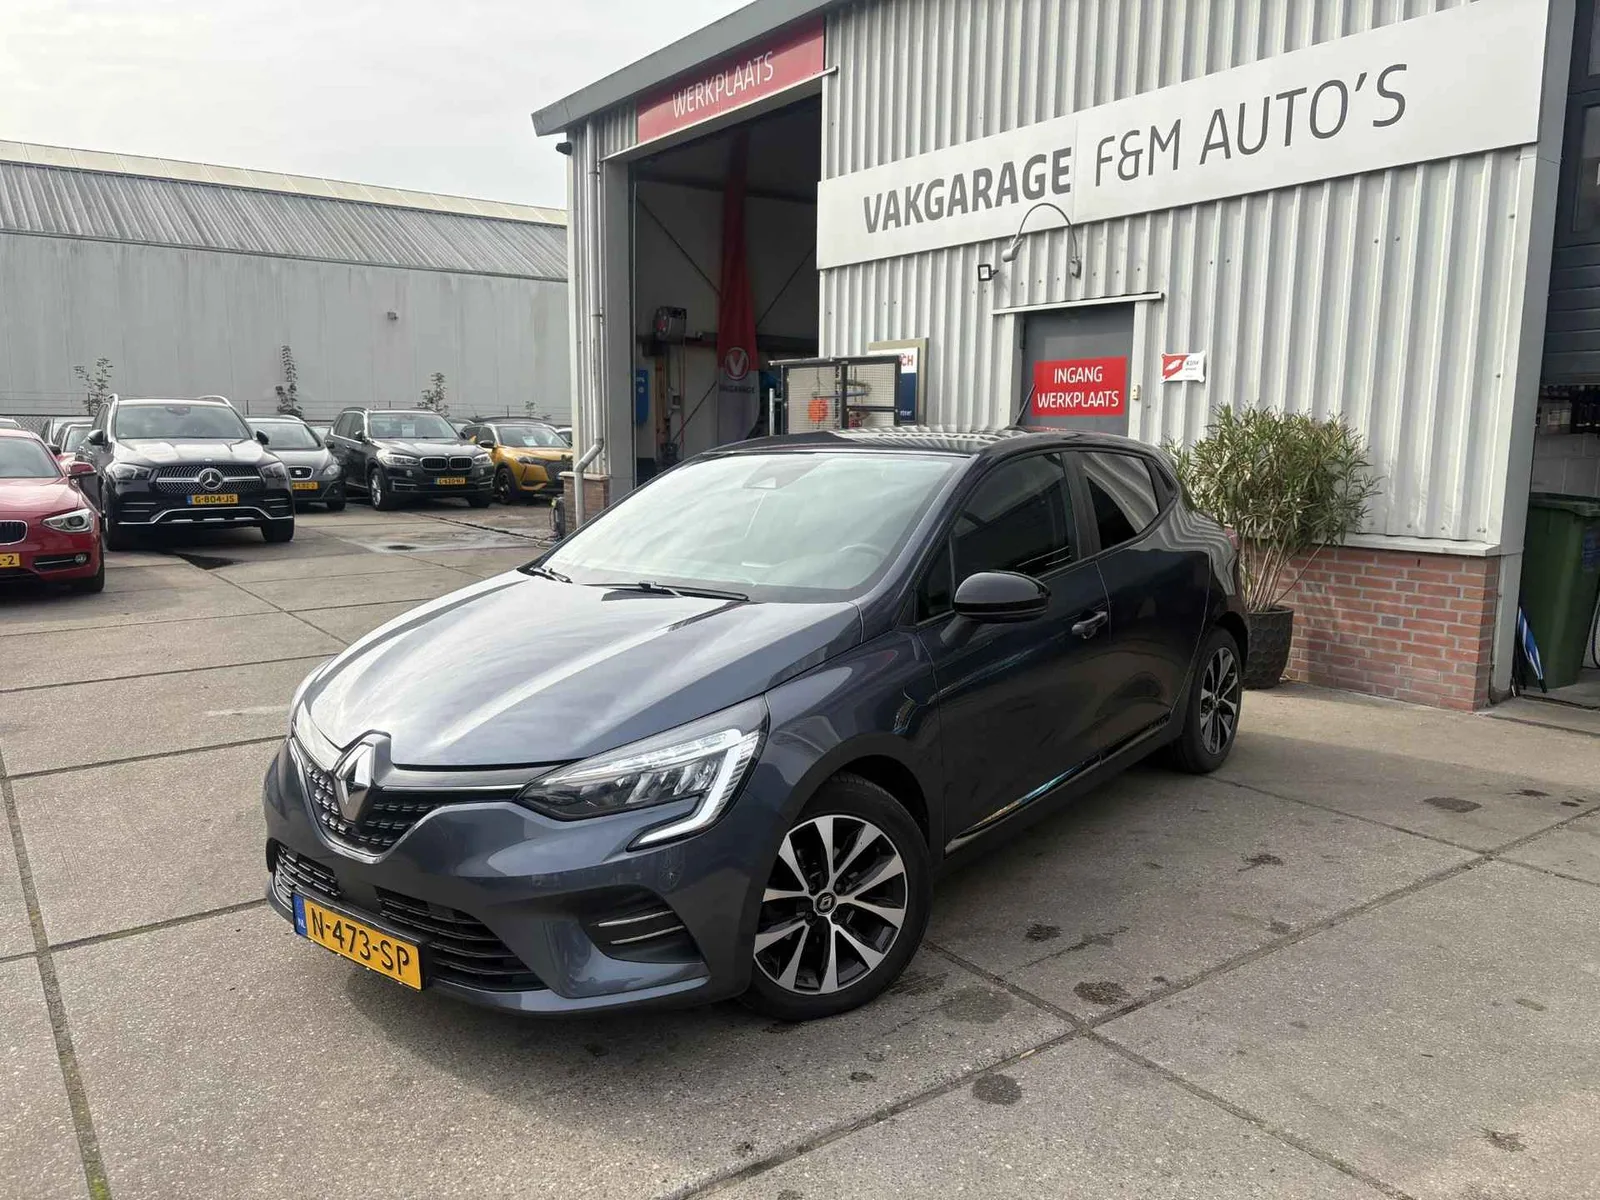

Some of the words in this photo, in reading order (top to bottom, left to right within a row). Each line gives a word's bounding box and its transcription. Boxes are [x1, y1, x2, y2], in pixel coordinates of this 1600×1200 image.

[672, 51, 774, 118] WERKPLAATS
[863, 146, 1072, 234] VAKGARAGE
[1095, 118, 1181, 187] F&M
[1199, 63, 1408, 165] AUTO'S
[1054, 366, 1103, 384] INGANG
[1037, 390, 1119, 409] WERKPLAATS
[194, 495, 235, 504] G-804-JS
[311, 907, 410, 976] N-473-SP
